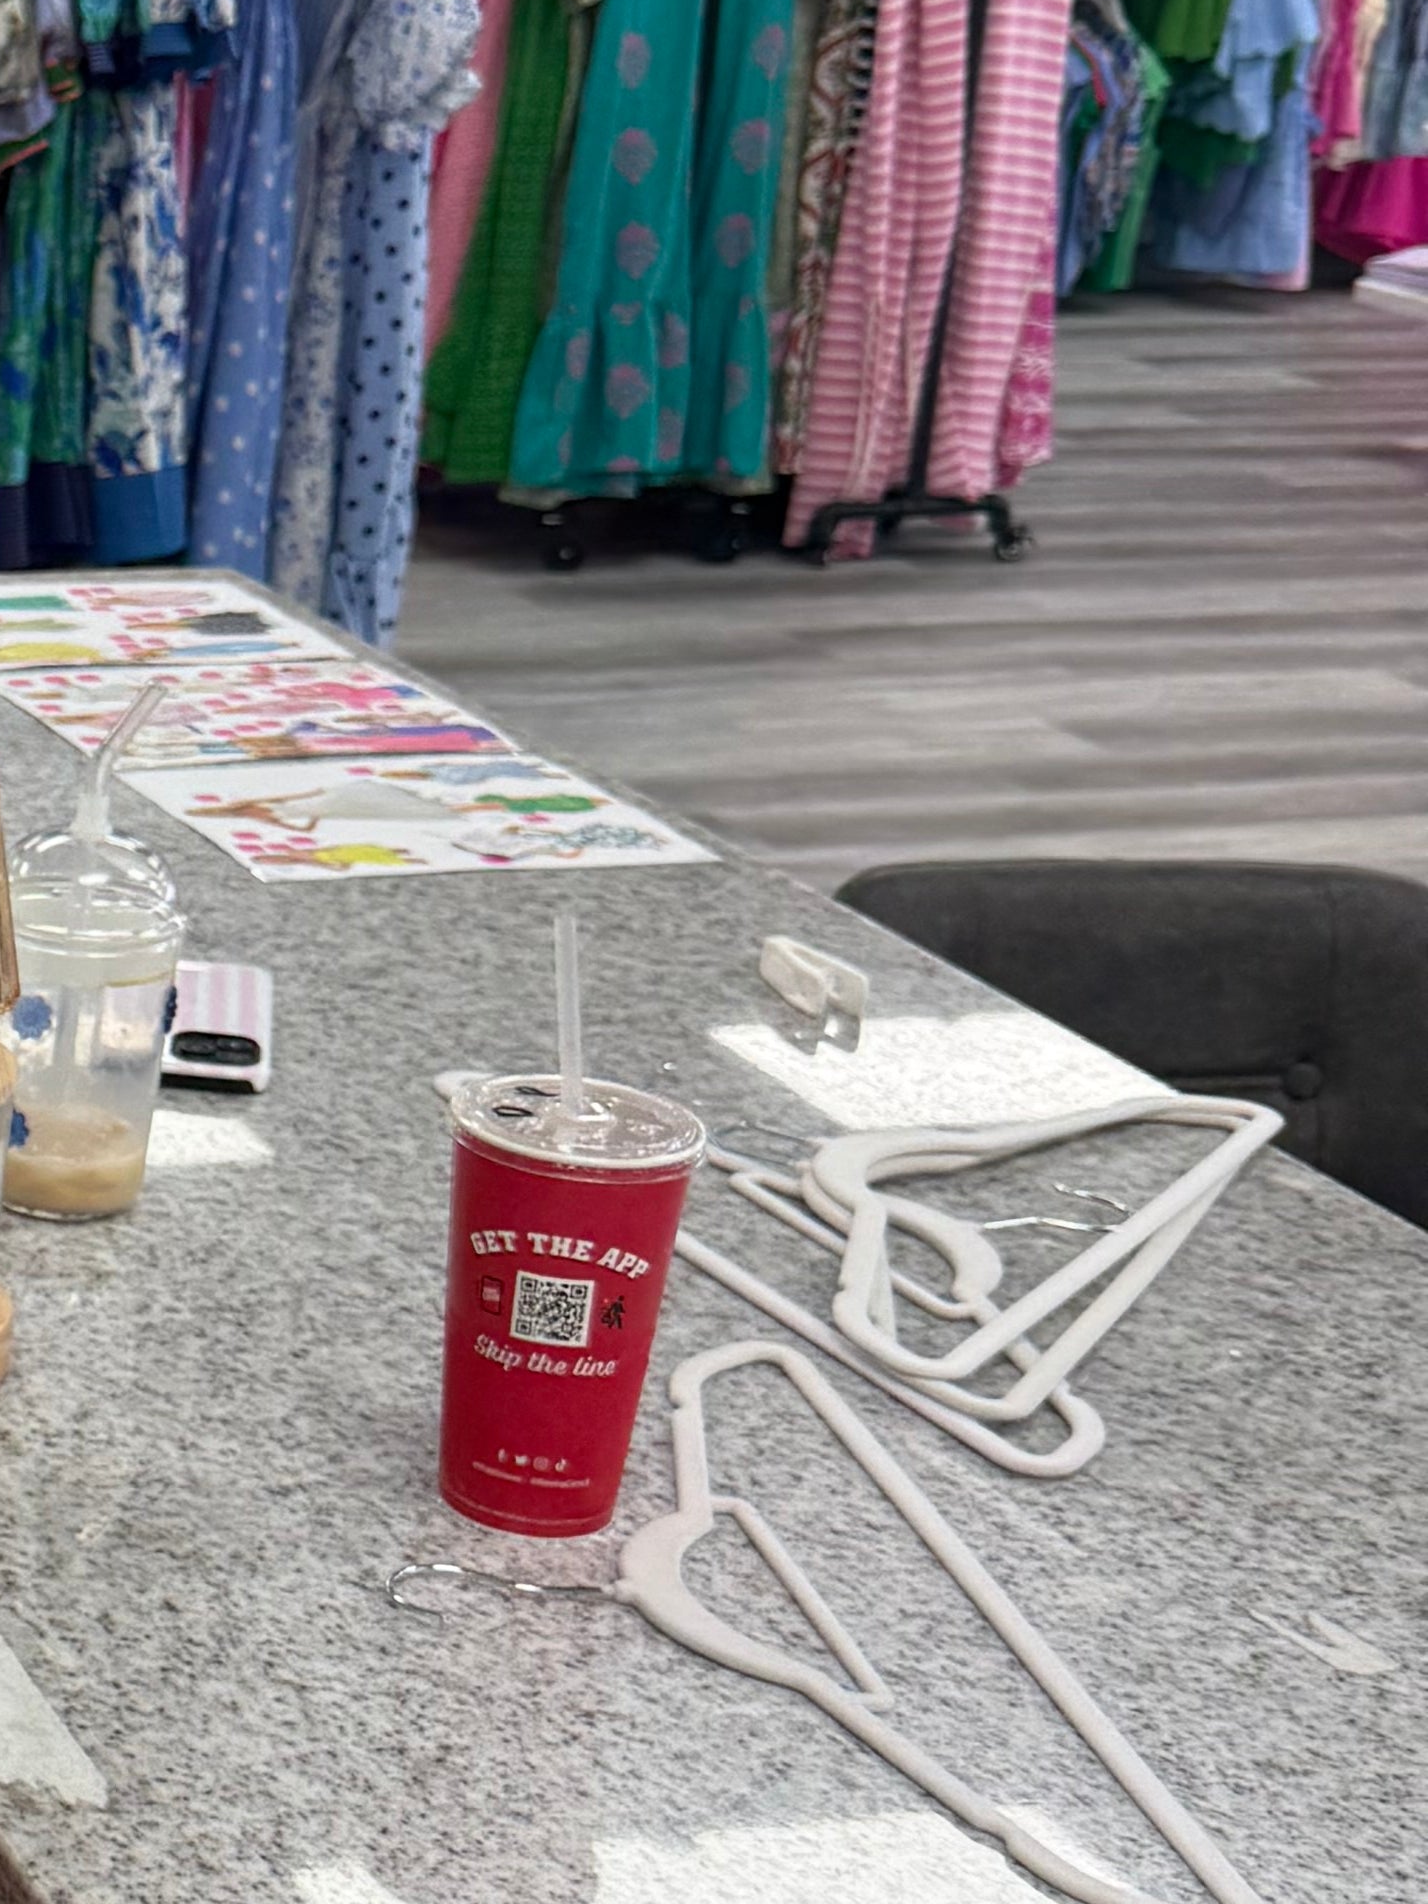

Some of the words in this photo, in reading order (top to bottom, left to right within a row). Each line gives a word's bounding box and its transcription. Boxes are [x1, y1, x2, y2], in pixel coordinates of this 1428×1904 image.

[470, 1229, 518, 1255] GET
[527, 1232, 595, 1262] THE
[597, 1247, 651, 1280] APP
[474, 1334, 522, 1372] Skip
[527, 1352, 568, 1376] the
[572, 1356, 617, 1377] line
